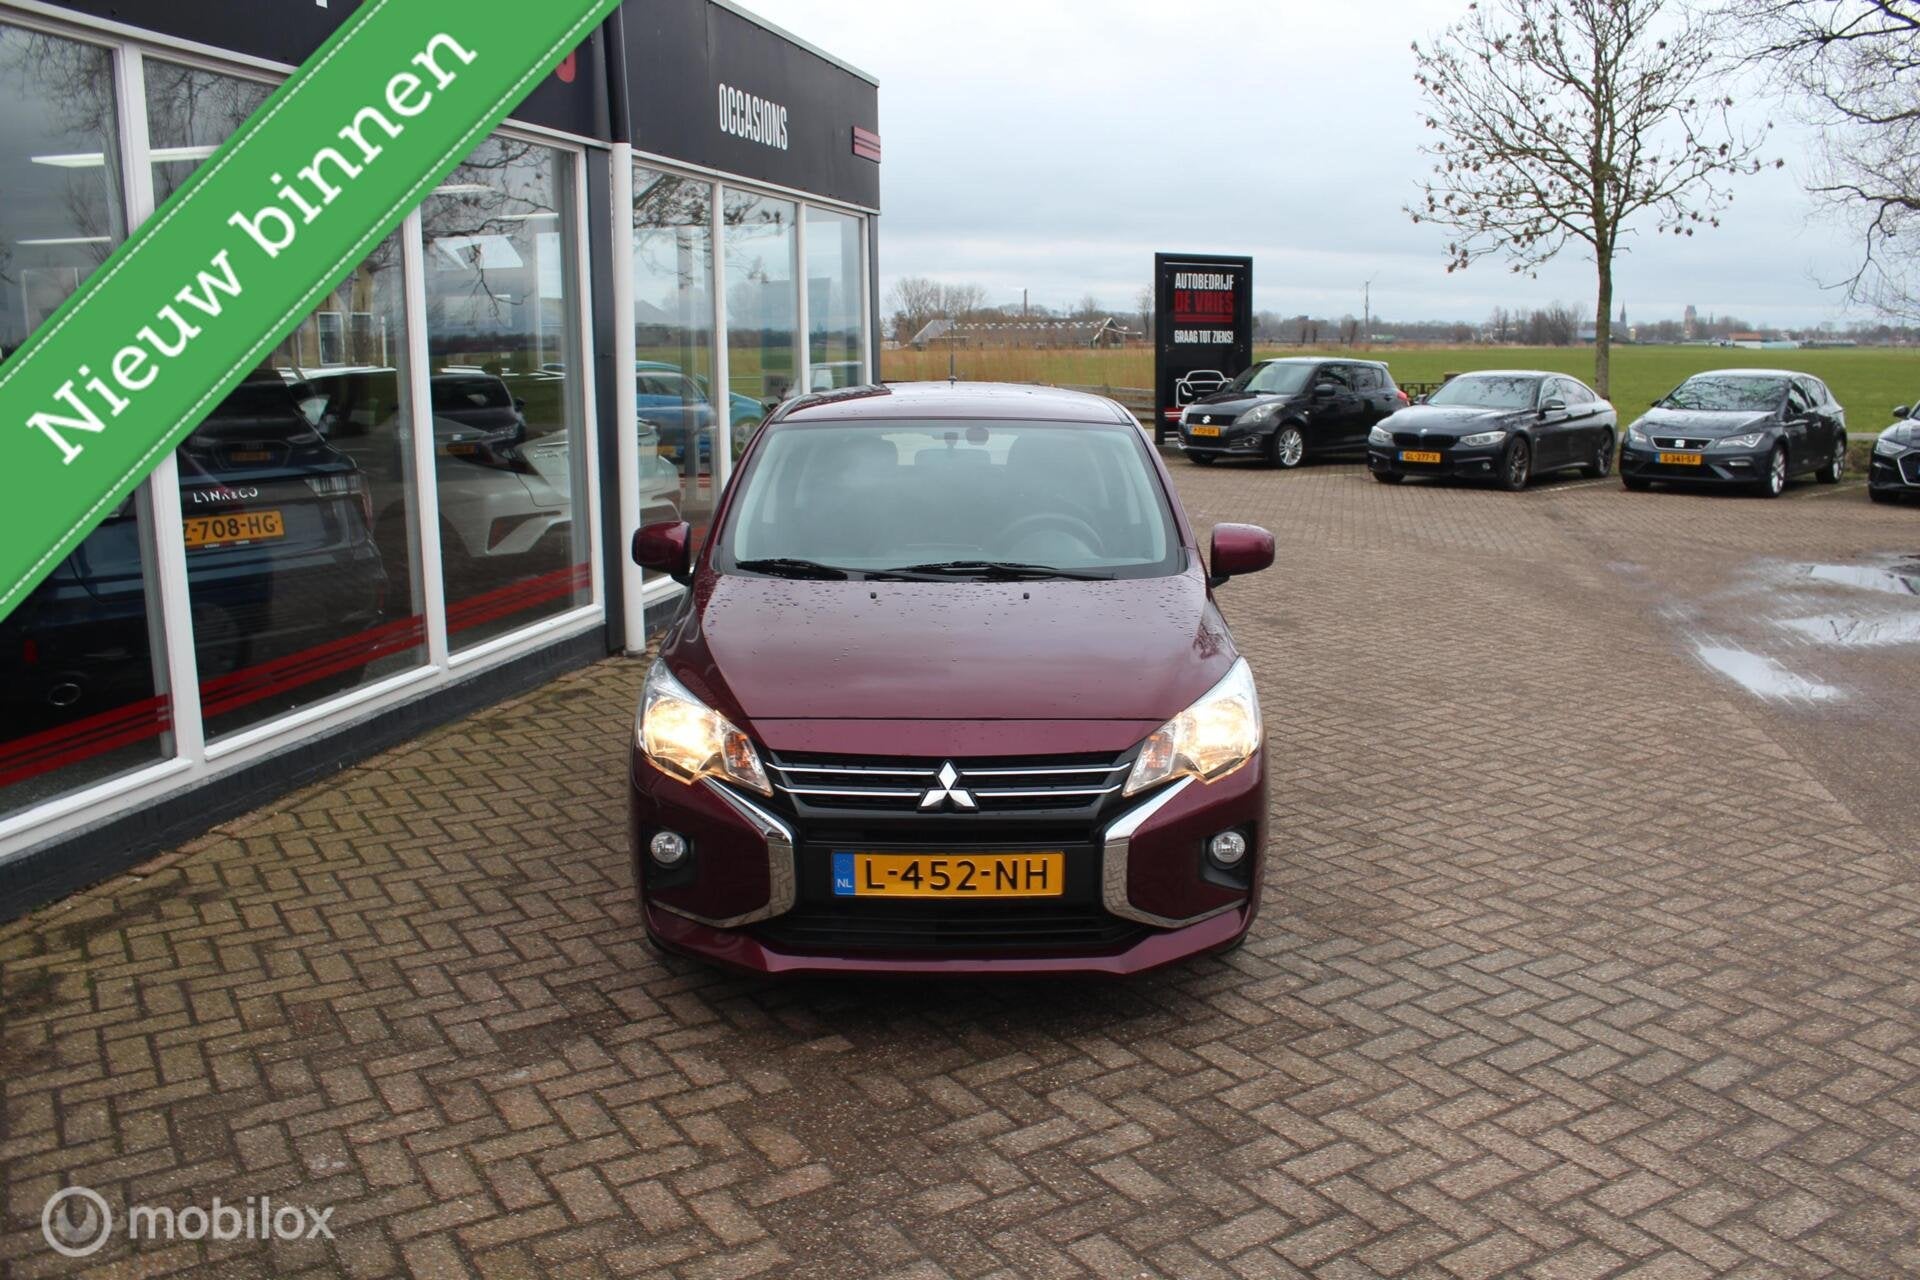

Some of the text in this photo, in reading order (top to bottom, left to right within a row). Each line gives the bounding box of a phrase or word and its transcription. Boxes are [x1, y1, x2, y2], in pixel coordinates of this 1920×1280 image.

[718, 83, 788, 151] OCCASIONS
[1174, 272, 1234, 291] AUTOBEDRIJF
[1174, 290, 1234, 313] DE VRIES
[1174, 330, 1234, 344] GRAAG TOT ZIENS!
[837, 859, 1048, 891] NL L-452-NH
